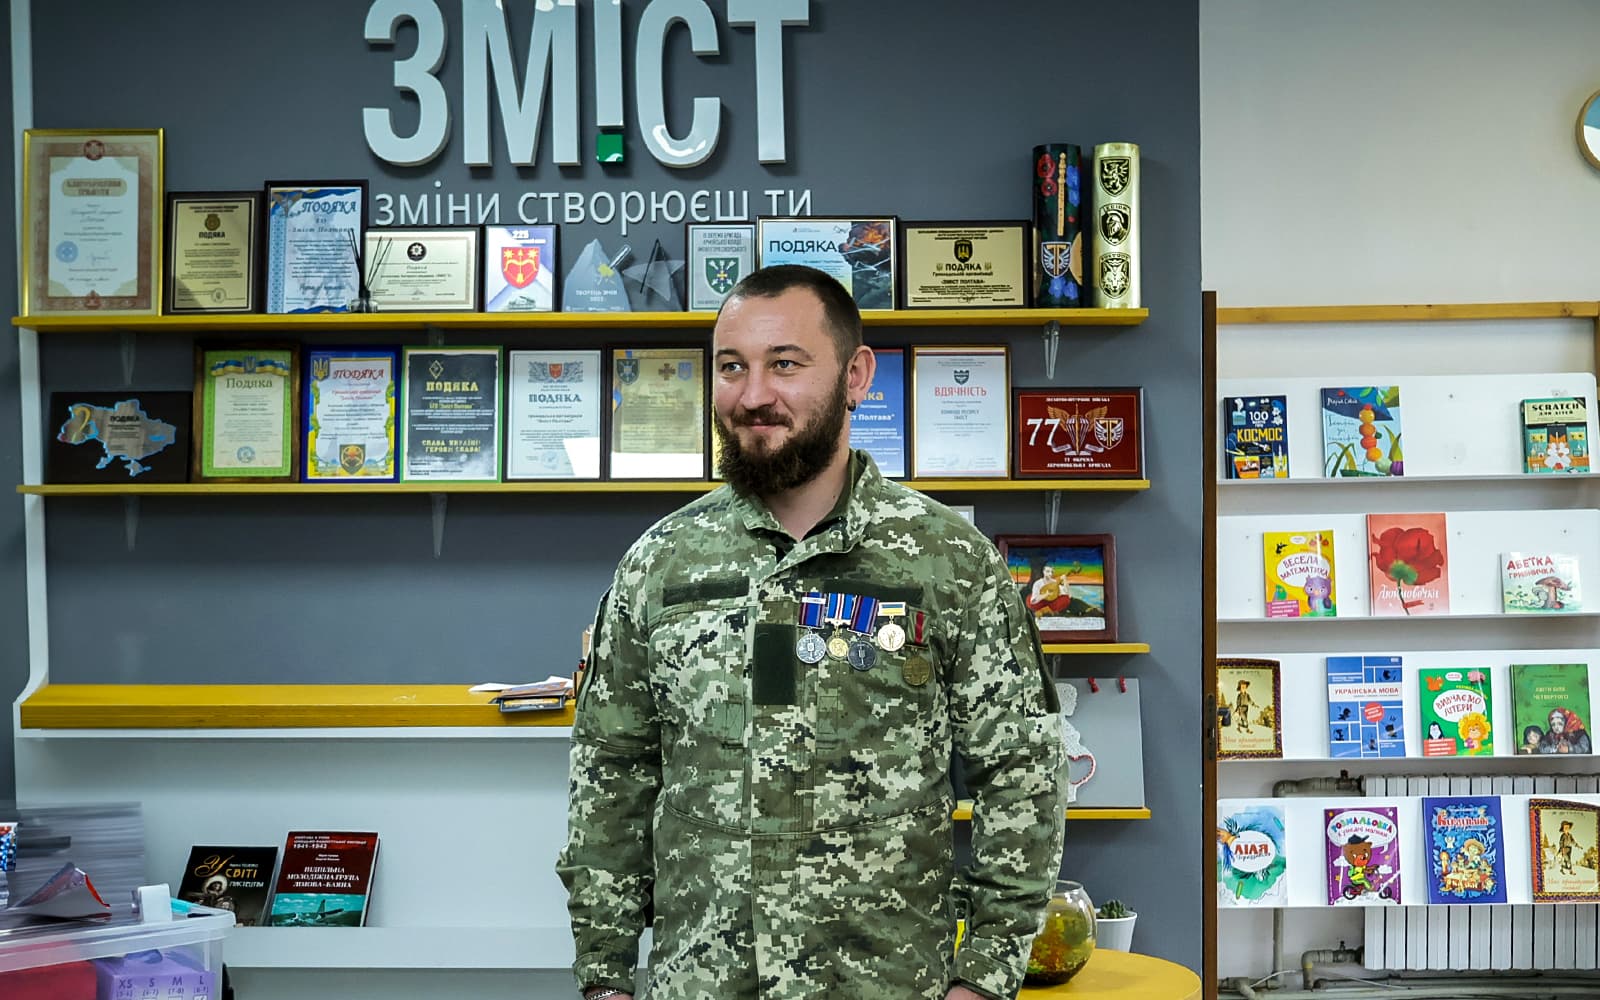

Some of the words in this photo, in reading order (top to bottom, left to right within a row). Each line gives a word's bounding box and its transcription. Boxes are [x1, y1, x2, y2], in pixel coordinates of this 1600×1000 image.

[301, 200, 357, 215] ПОДЯКА
[374, 181, 500, 226] зміни
[517, 189, 748, 236] створюєш
[764, 189, 812, 217] ти
[769, 240, 838, 255] ПОДЯКА
[945, 263, 983, 272] ПОДЯКА
[333, 368, 385, 381] ПОДЯКА
[226, 377, 273, 390] Подяка
[425, 382, 479, 393] ПОДЯКА
[528, 393, 583, 404] ПОДЯКА
[934, 386, 988, 398] ВДЯЧНІСТЬ
[1531, 403, 1579, 412] SCRATCH
[1249, 411, 1269, 421] 100
[1026, 418, 1061, 446] 77
[1236, 427, 1283, 443] КОСМОС
[1282, 555, 1319, 569] ВЕСЕЛА
[1506, 555, 1554, 570] АБЕТКА
[1280, 566, 1328, 580] МАТЕМАТИКА
[1334, 687, 1377, 695] УКРАЇНСЬКА
[1435, 693, 1482, 710] ВИВЧАЄМО
[1444, 703, 1473, 717] ЛІТЕРИ
[1331, 816, 1393, 833] РОЗМАЛЬОВКА
[1234, 843, 1269, 855] ЛІЛЯ
[194, 854, 236, 878] У
[225, 868, 257, 879] СВІТІ
[118, 979, 134, 989] XS
[149, 977, 156, 988] S
[171, 976, 184, 986] M
[199, 975, 205, 985] L
